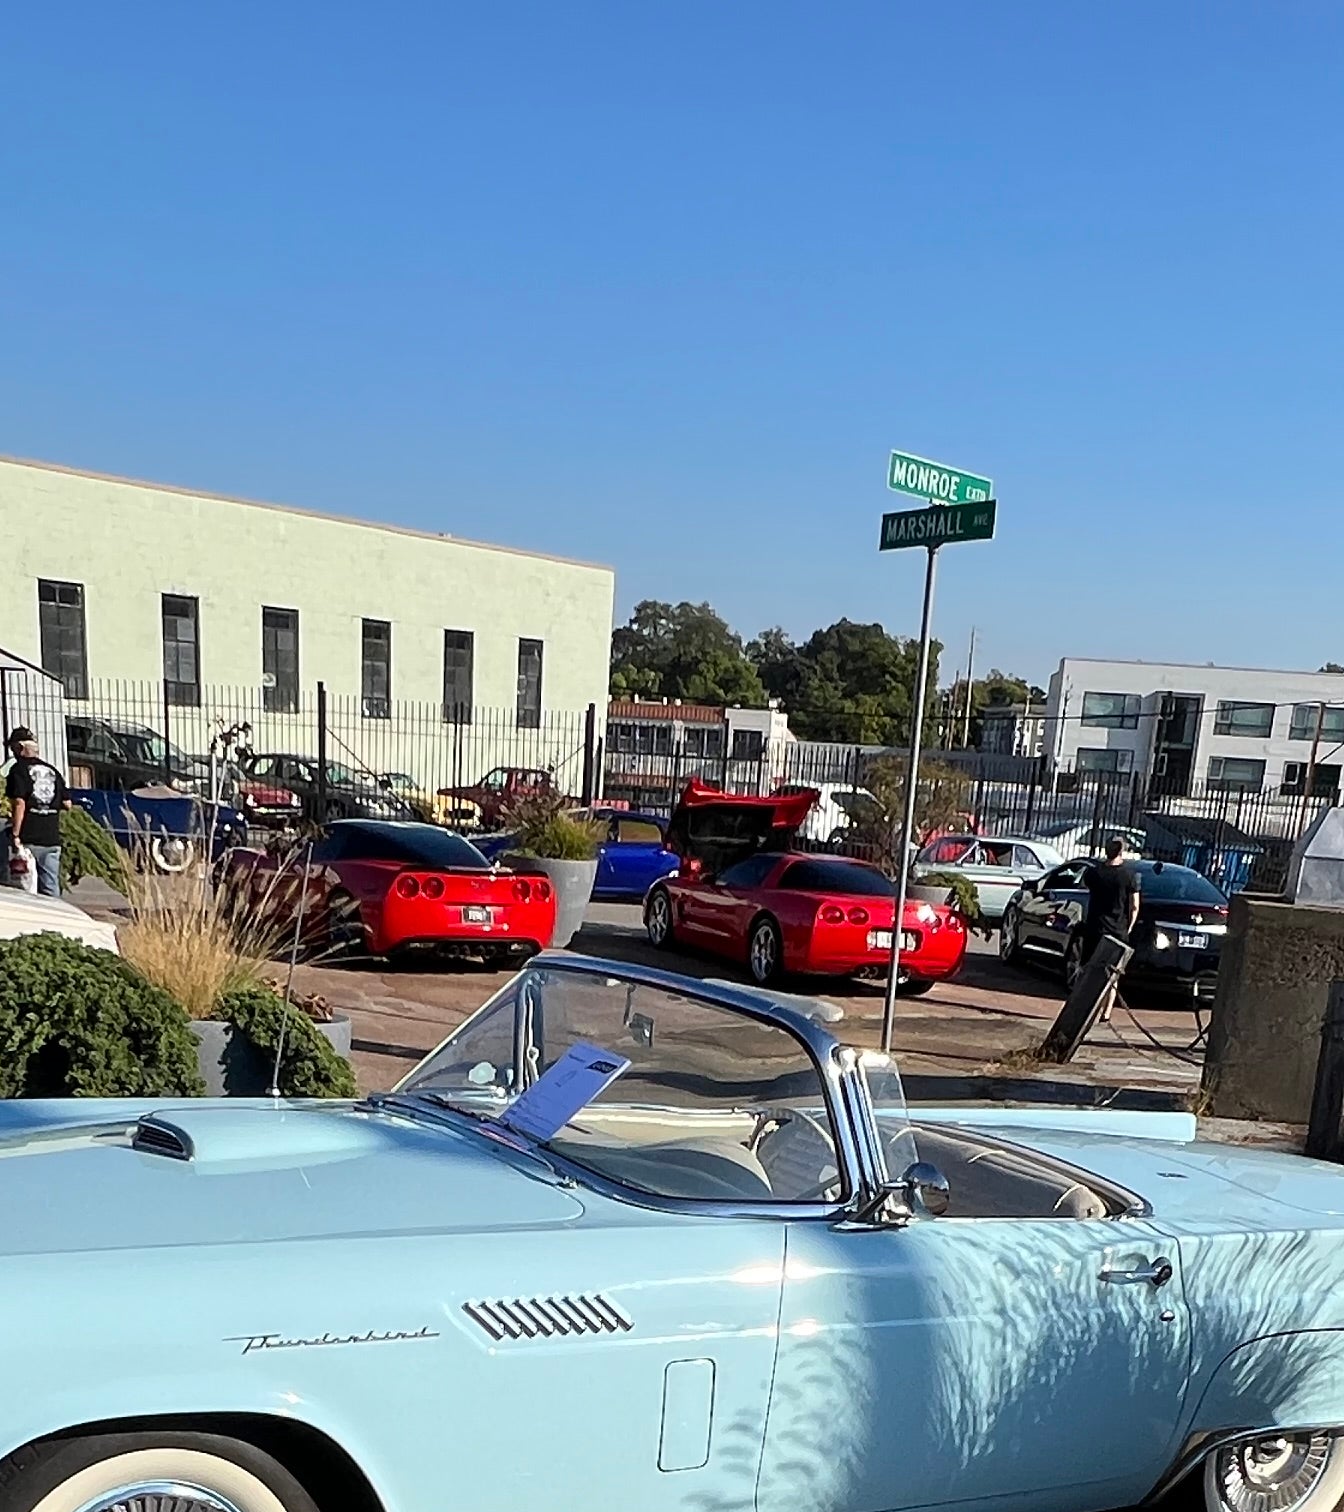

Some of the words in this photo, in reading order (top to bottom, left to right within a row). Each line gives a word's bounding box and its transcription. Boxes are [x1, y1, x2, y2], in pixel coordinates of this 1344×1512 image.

[893, 459, 960, 500] MONROE
[886, 511, 964, 542] MARSHALL
[222, 1326, 440, 1355] Thunderbird
